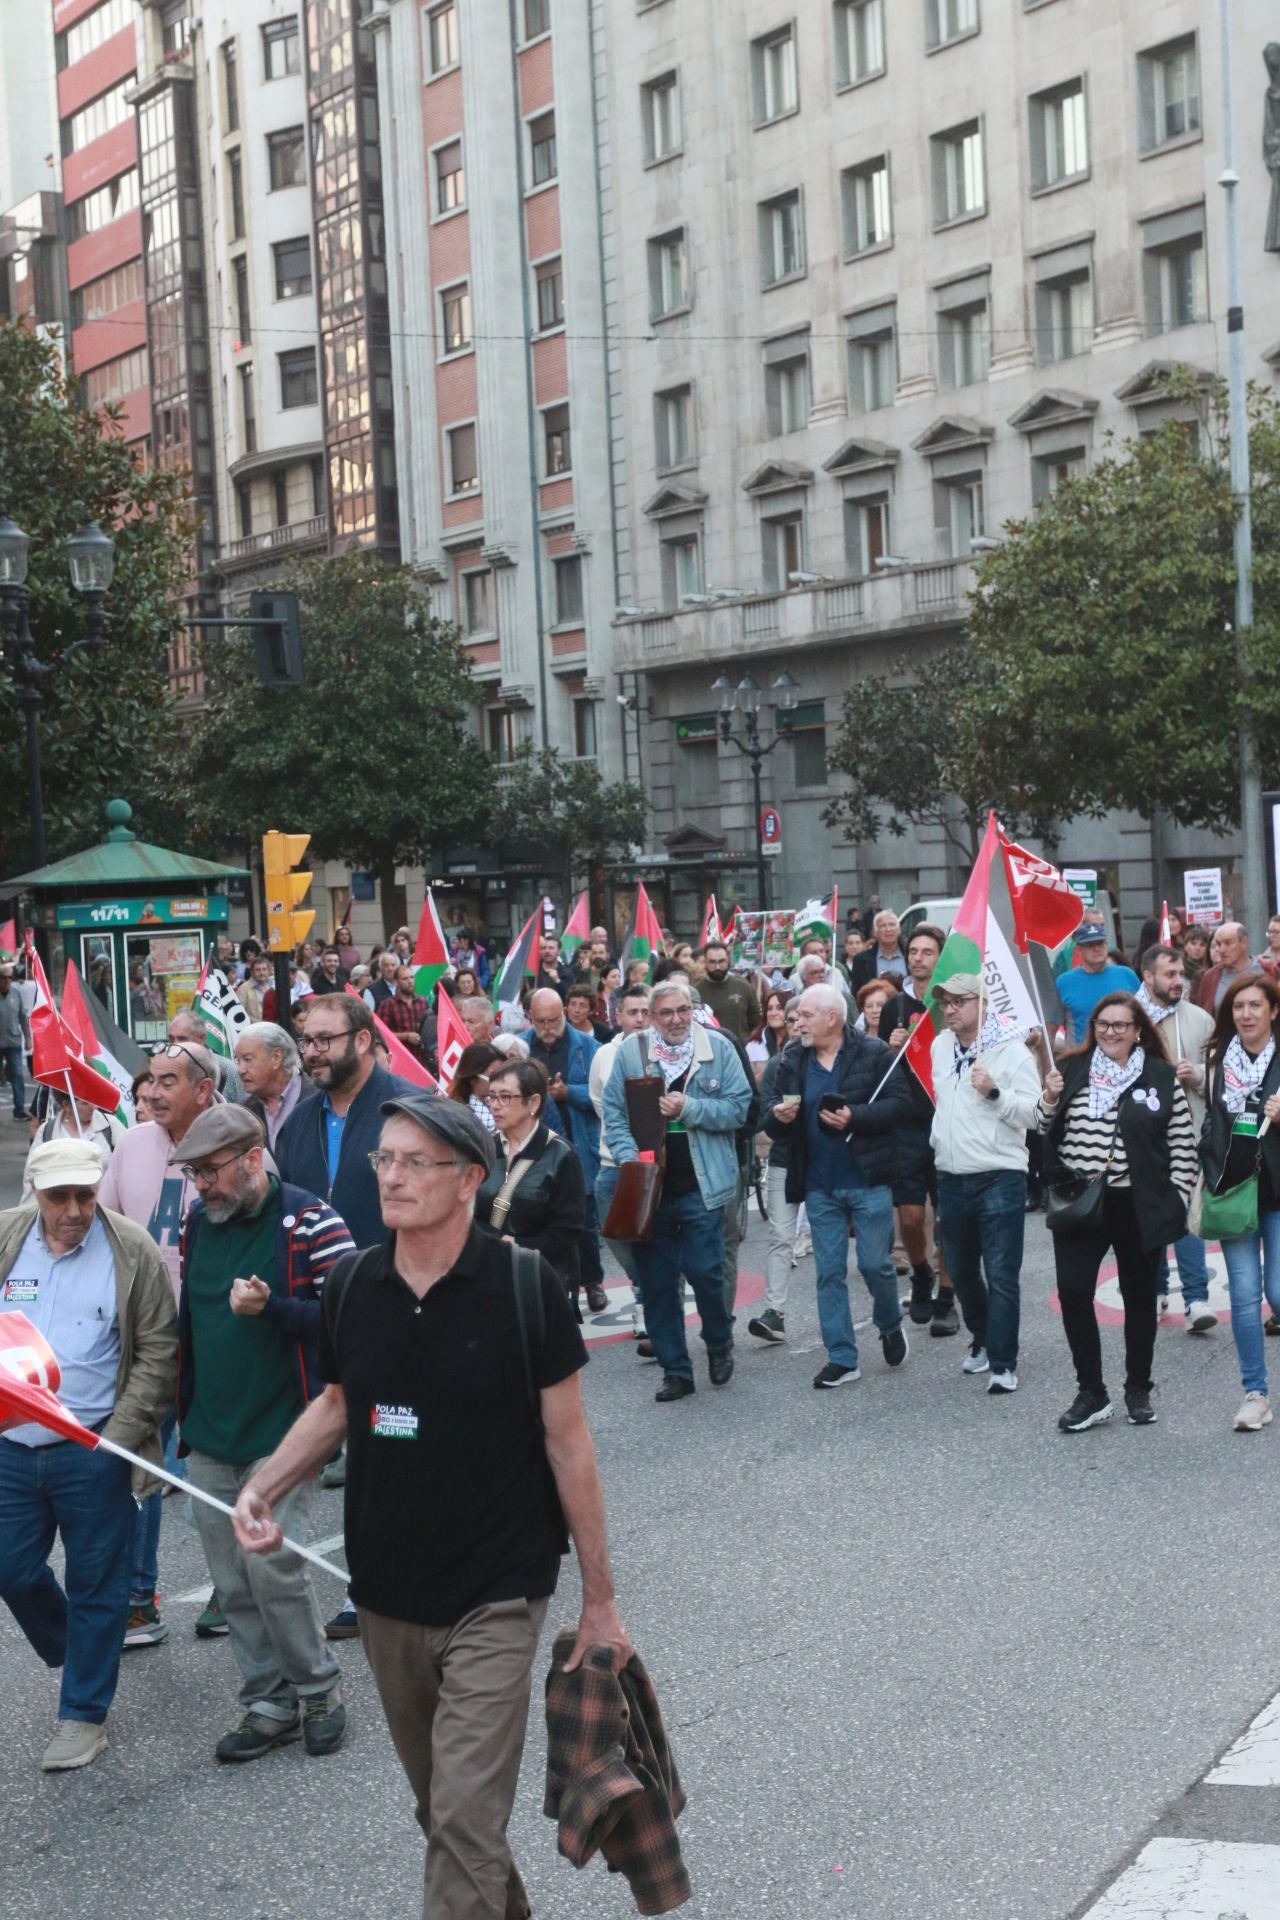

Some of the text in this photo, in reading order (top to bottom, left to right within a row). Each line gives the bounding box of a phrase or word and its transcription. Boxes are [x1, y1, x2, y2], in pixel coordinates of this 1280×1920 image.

[91, 908, 129, 921] 11/11
[375, 1404, 413, 1416] POLA PAZ
[375, 1425, 413, 1436] PALESTINA
